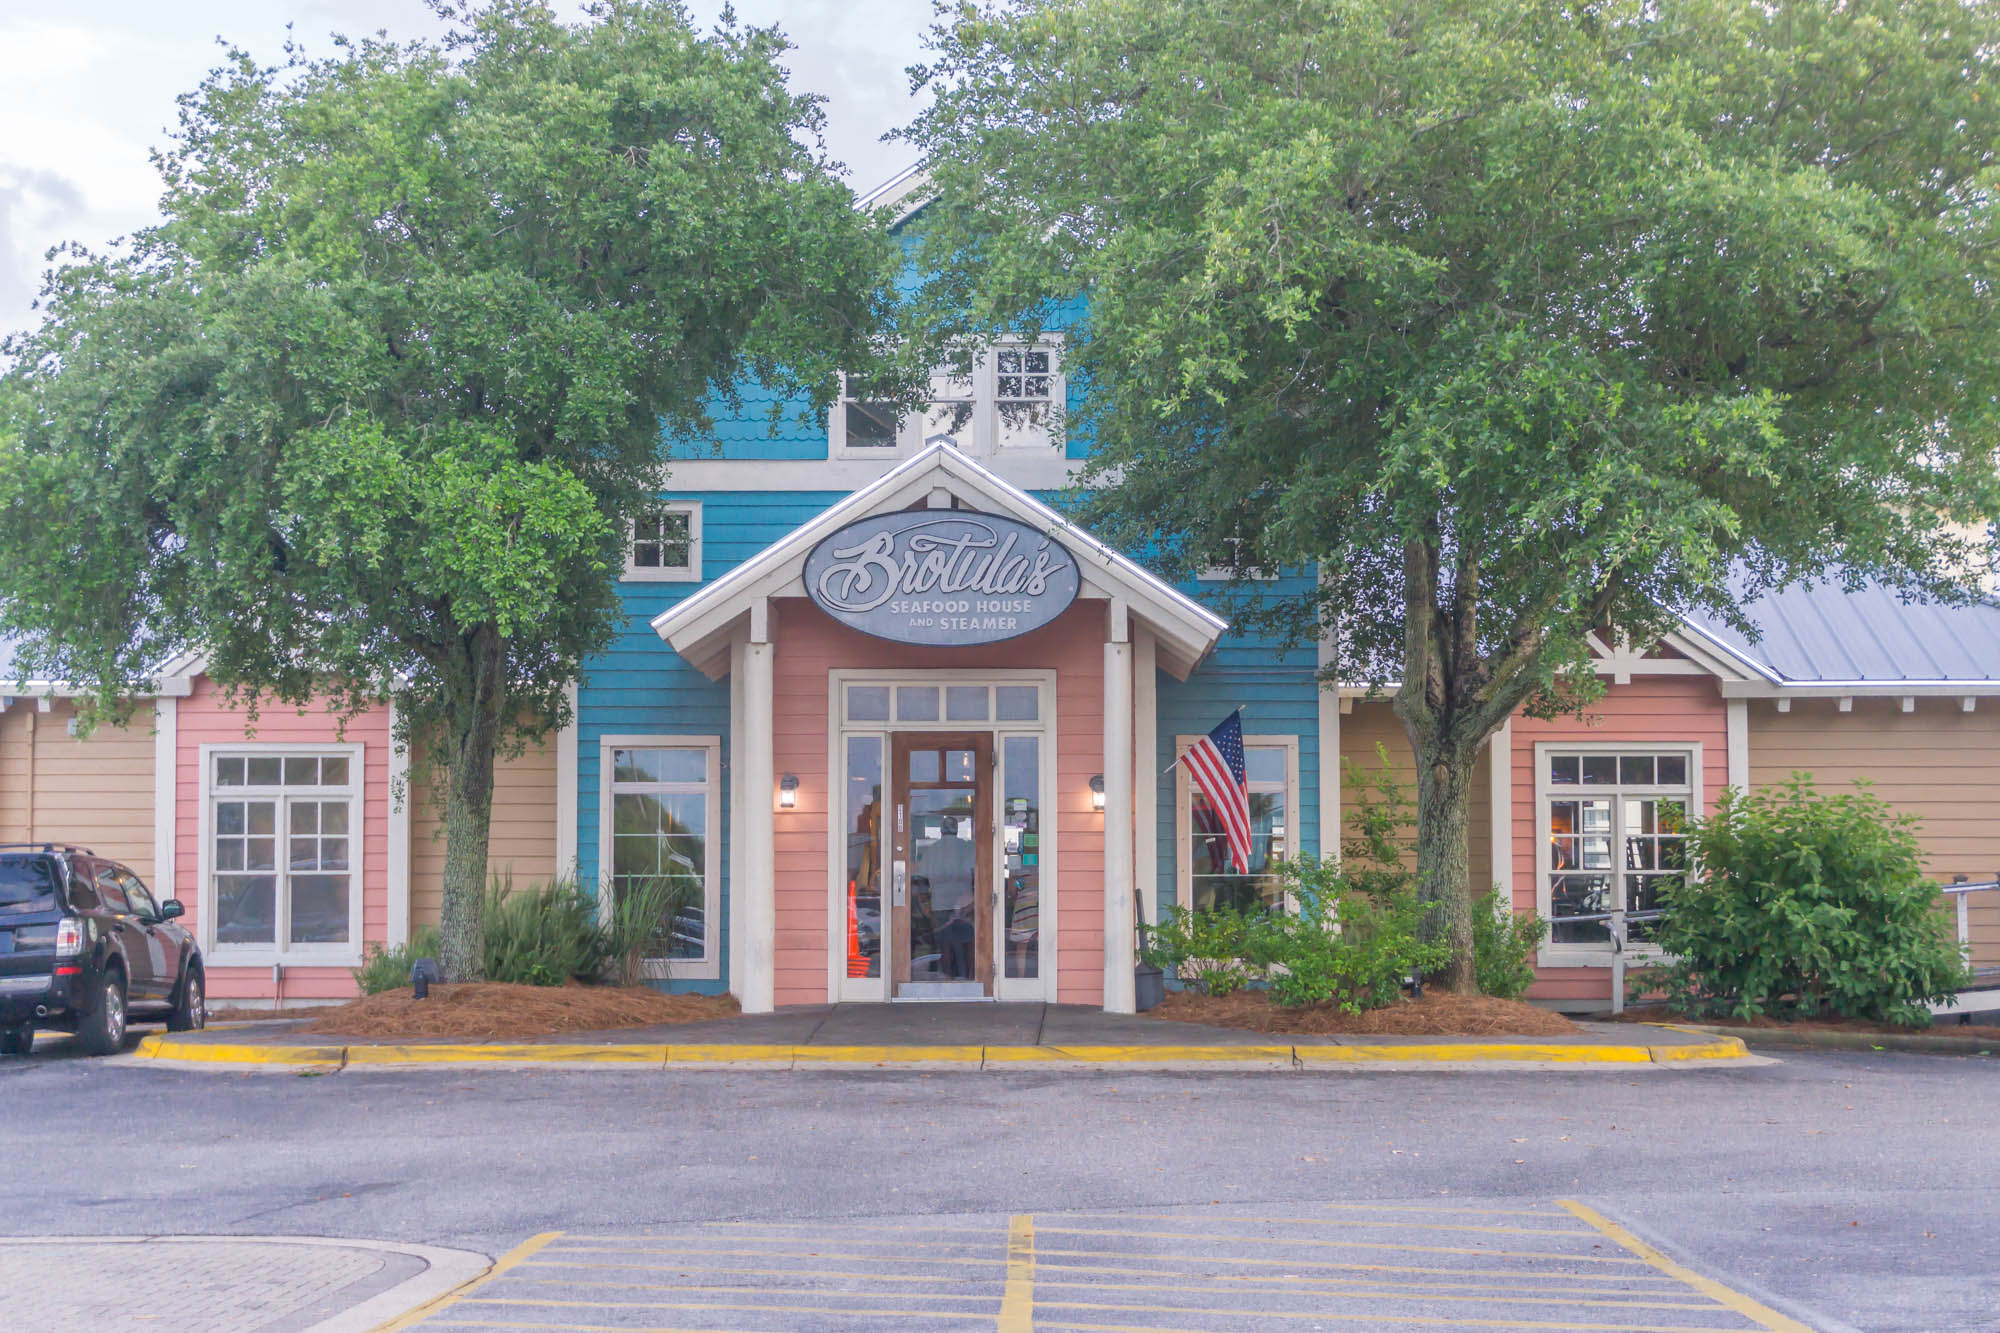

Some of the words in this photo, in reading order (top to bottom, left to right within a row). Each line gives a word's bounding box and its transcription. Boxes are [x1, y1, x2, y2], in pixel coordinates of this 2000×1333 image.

[817, 519, 1068, 613] Brotula's
[890, 600, 970, 614] SEAFOOD
[976, 600, 1032, 613] HOUSE
[909, 618, 934, 627] AND
[940, 617, 1017, 631] STEAMER
